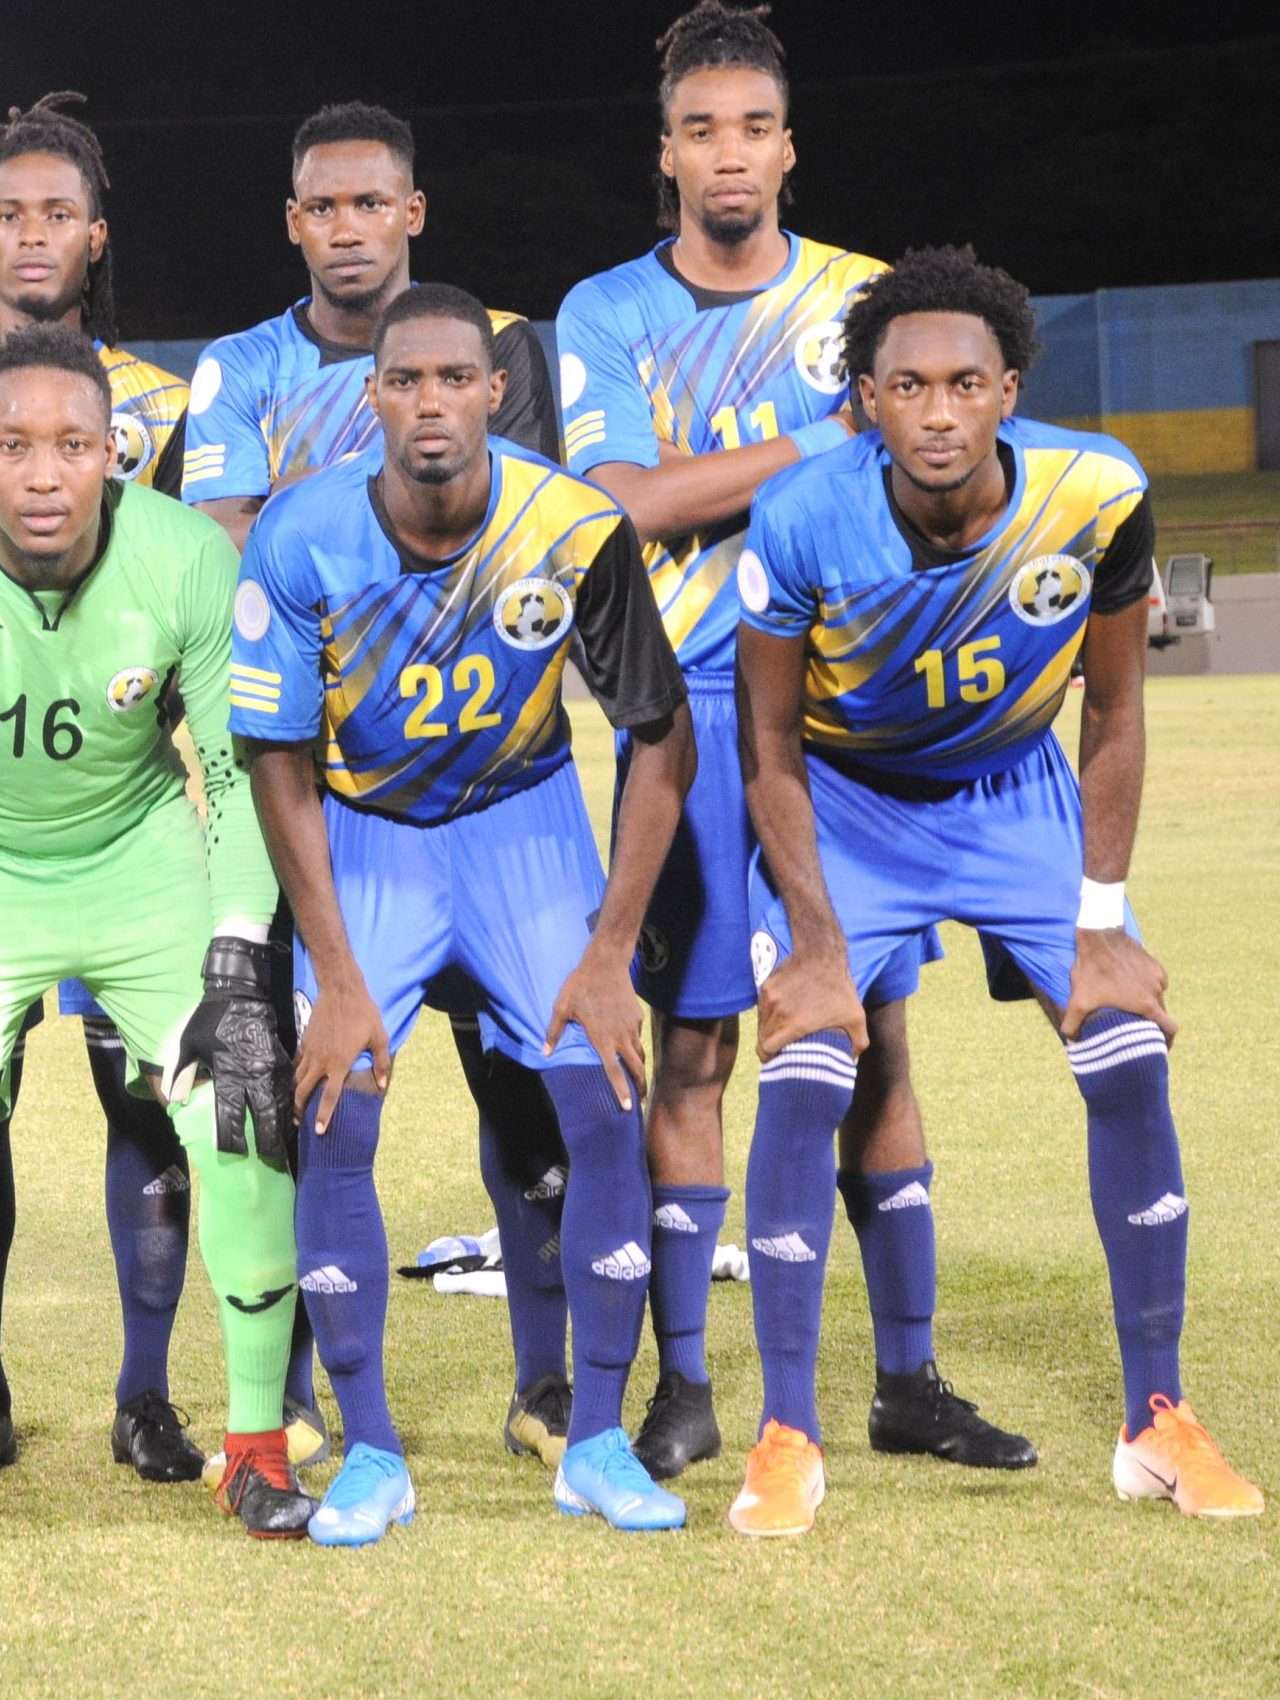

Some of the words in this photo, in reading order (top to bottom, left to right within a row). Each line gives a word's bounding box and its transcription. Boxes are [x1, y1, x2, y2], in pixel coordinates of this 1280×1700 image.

[710, 400, 780, 451] 11
[399, 653, 503, 740] 22
[913, 633, 1006, 708] 15
